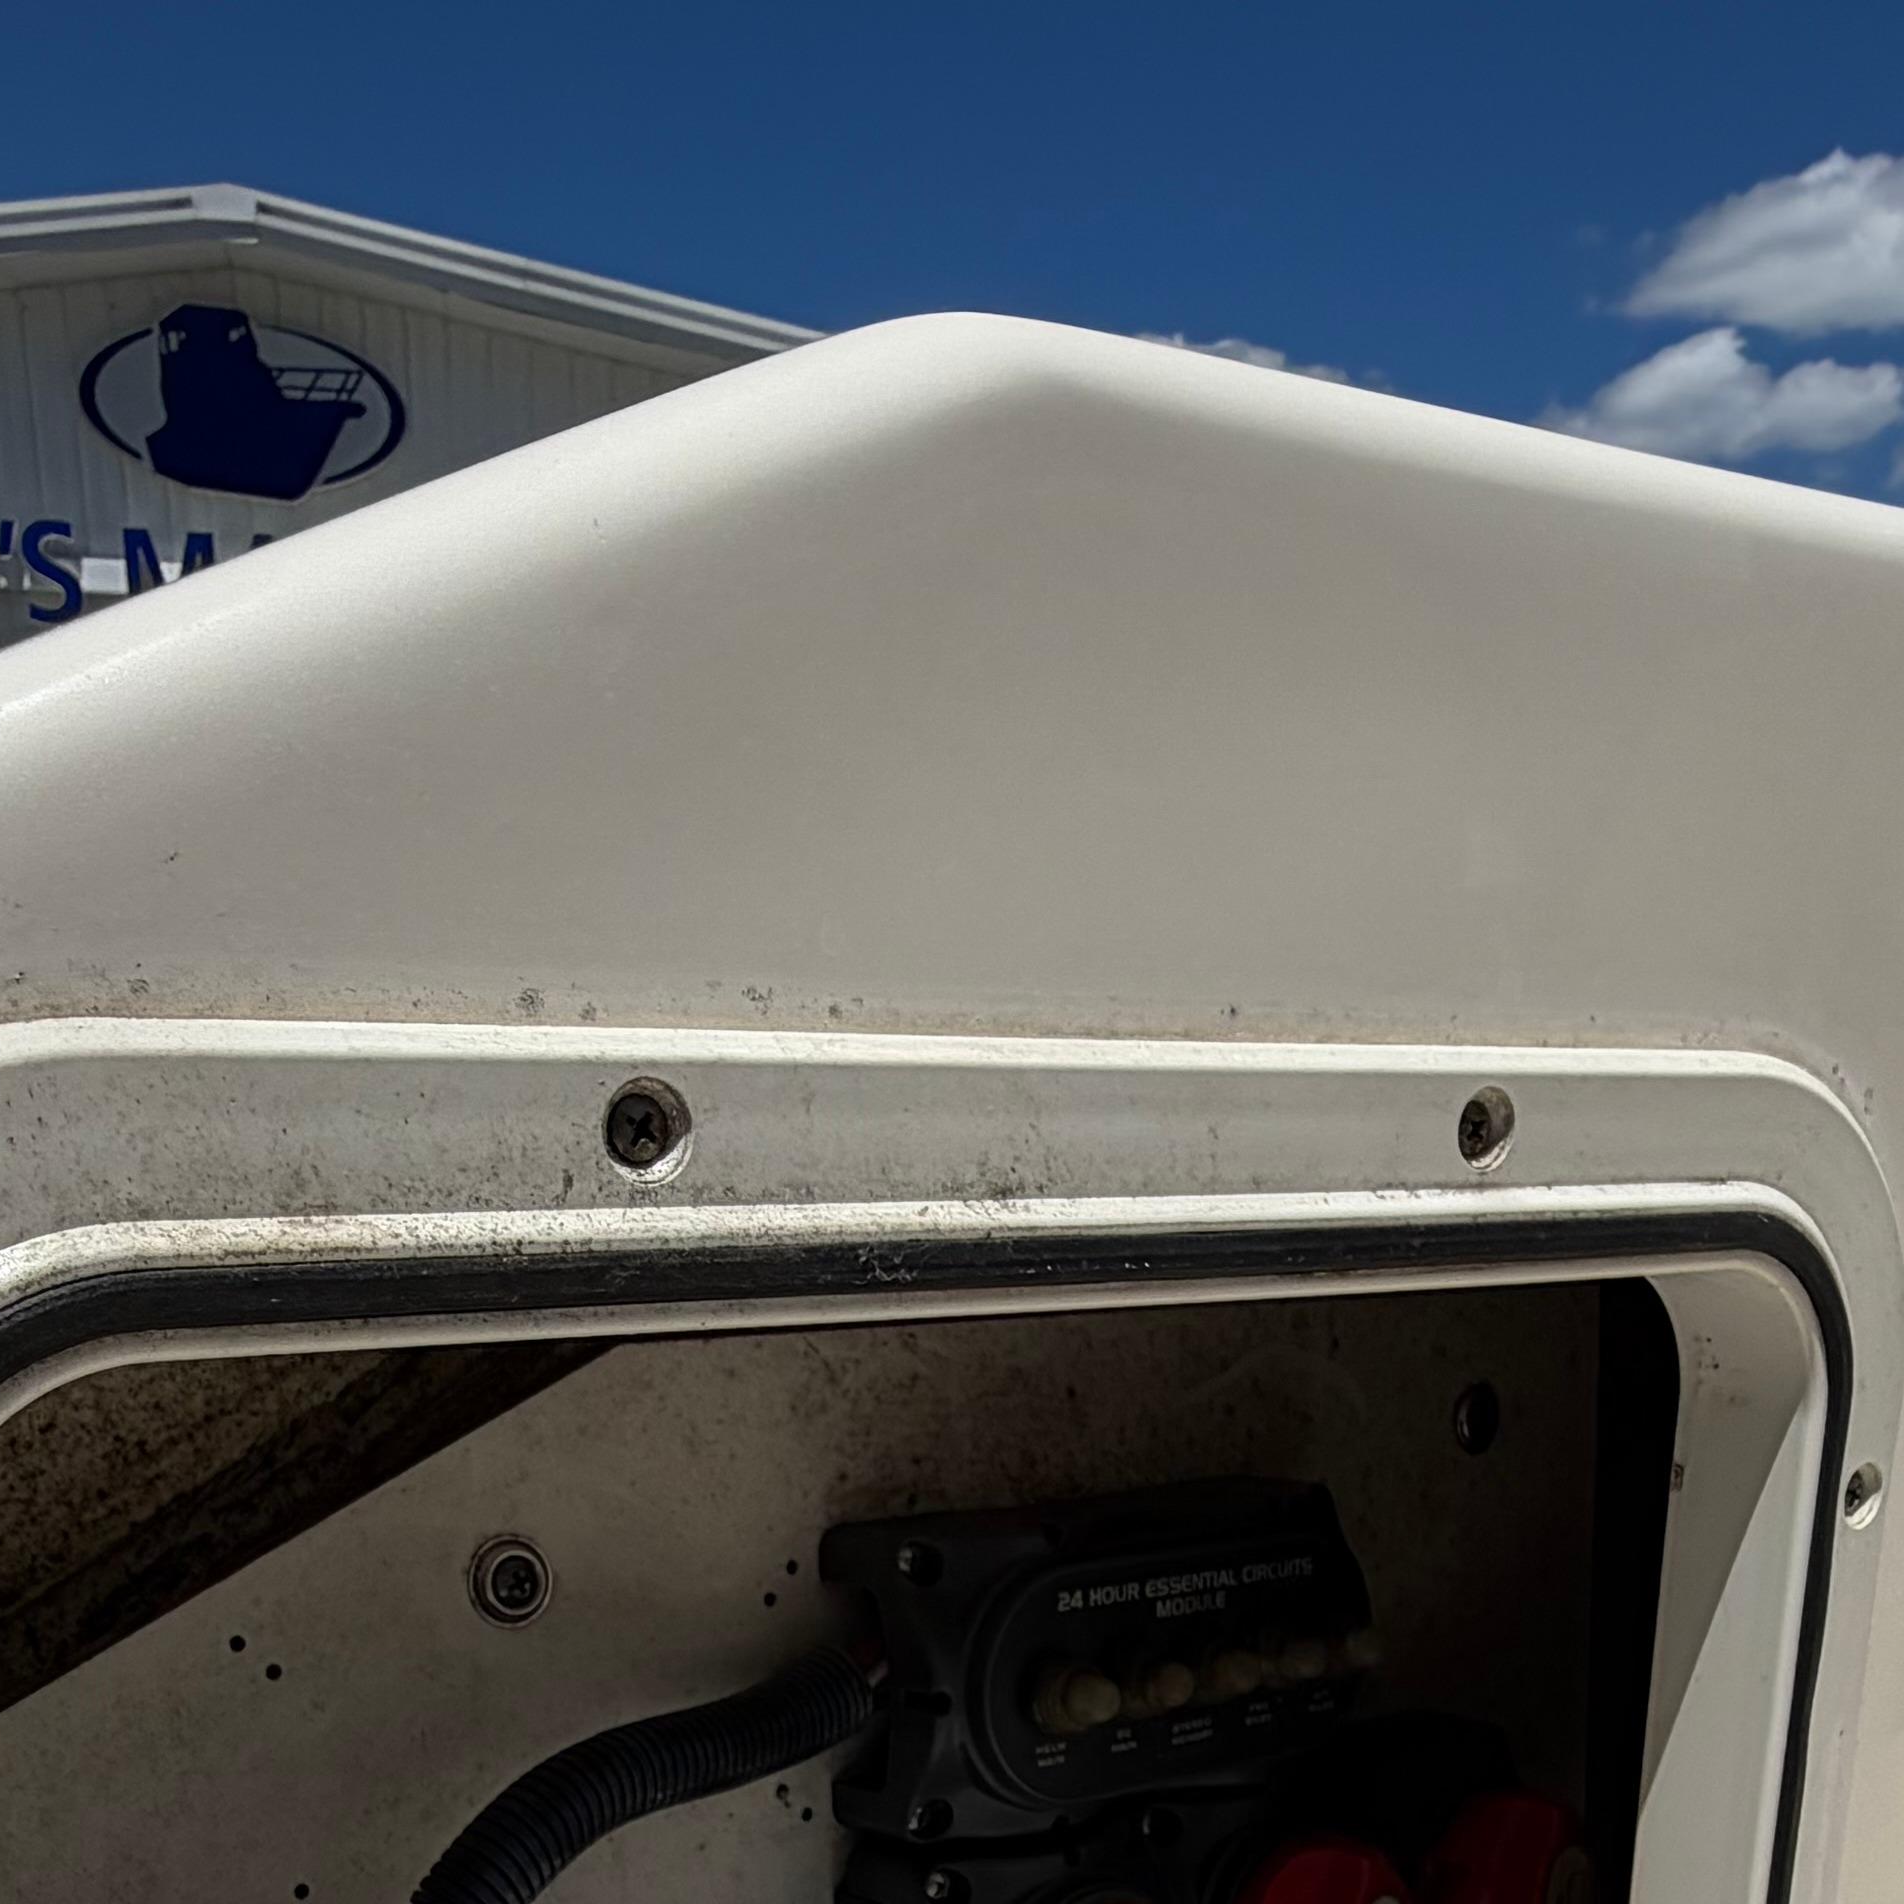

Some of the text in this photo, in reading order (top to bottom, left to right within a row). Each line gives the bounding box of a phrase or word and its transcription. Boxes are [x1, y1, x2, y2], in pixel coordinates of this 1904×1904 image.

[122, 528, 276, 595] M
[1057, 1557, 1314, 1612] 24 HOUR ESSENTIAL CIRCUITS
[1156, 1590, 1227, 1618] MODULE
